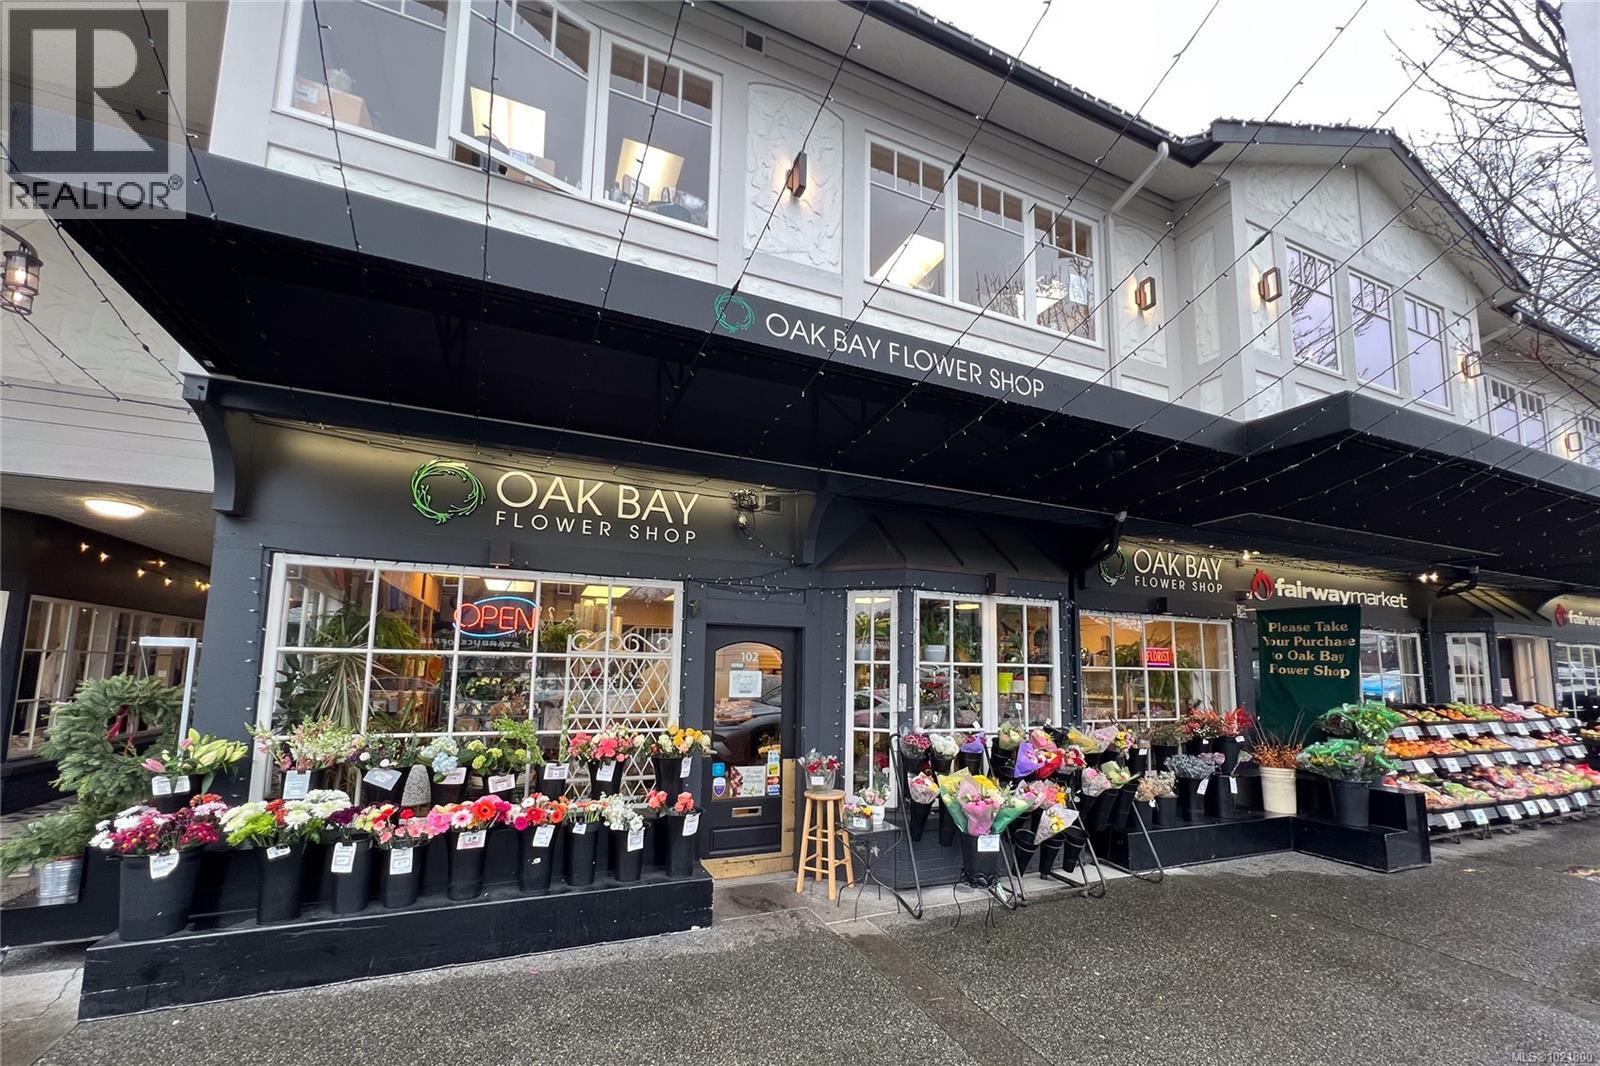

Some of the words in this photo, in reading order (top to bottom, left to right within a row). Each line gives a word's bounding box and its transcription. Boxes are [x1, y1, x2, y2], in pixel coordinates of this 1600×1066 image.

[765, 312, 827, 348] OAK
[833, 328, 882, 360] BAY
[889, 343, 983, 385] FLOWER
[989, 368, 1045, 398] SHOP
[496, 470, 605, 517] OAK
[617, 484, 700, 525] BAY
[495, 510, 613, 537] FLOWER
[629, 524, 697, 545] SHOP
[1133, 548, 1181, 577] OAK
[1185, 554, 1223, 581] BAY
[1134, 575, 1186, 591] FLOWER
[1192, 580, 1223, 594] SHOP
[1274, 577, 1409, 609] fairwaymarket
[453, 602, 539, 631] OPEN
[1268, 622, 1311, 633] Please
[1313, 620, 1349, 632] Take
[1262, 635, 1290, 647] Your
[1293, 635, 1356, 647] Purchase
[741, 651, 759, 662] 102
[1145, 650, 1170, 662] FLORIST
[1287, 649, 1315, 661] Oak
[1319, 650, 1345, 664] Bay
[1268, 663, 1310, 675] Fower
[1313, 664, 1351, 679] Shop
